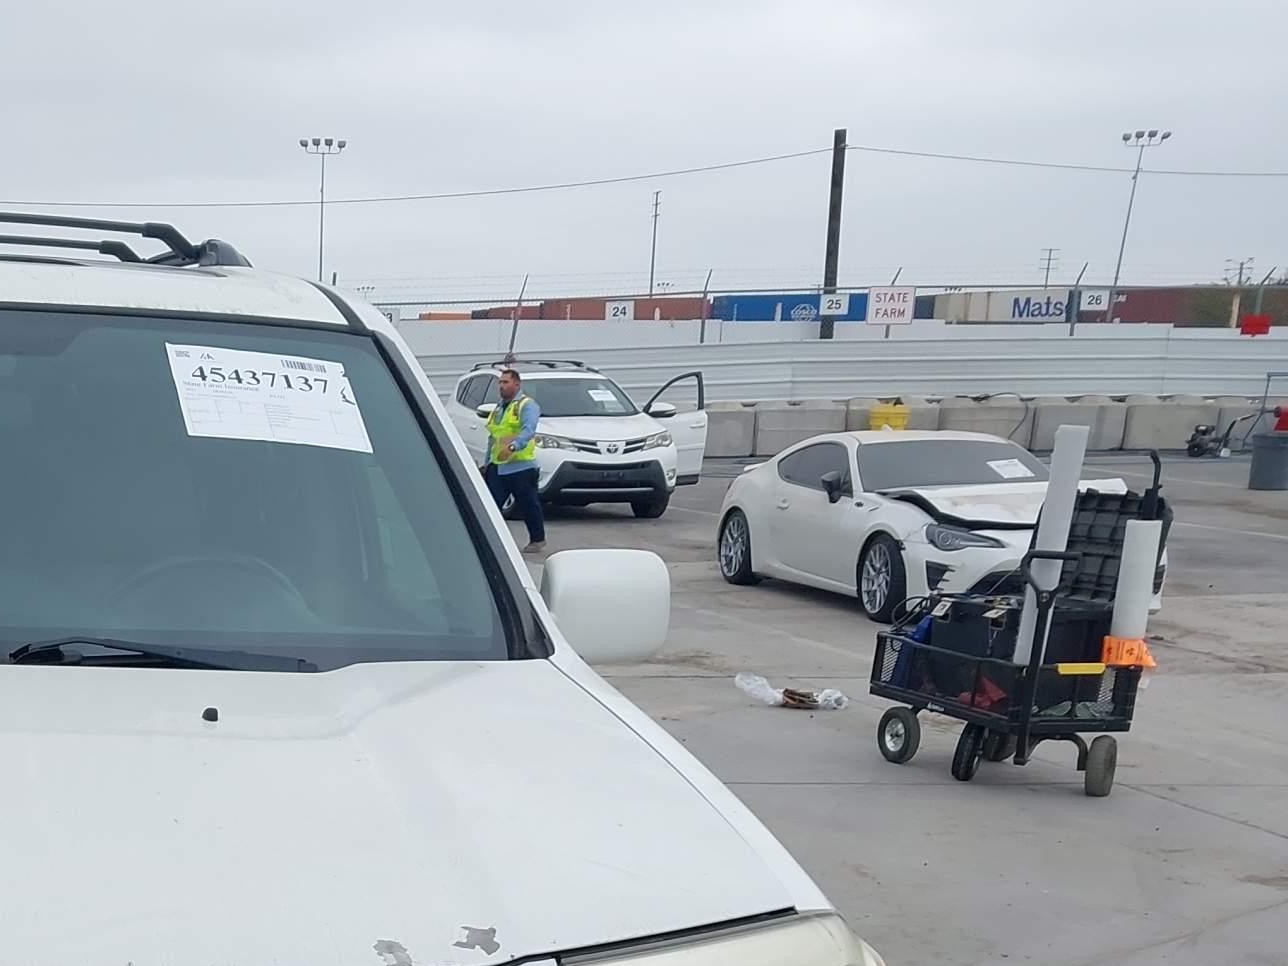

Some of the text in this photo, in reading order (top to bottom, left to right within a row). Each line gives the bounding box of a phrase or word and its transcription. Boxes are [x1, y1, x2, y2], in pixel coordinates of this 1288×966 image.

[874, 291, 909, 304] STATE
[1087, 295, 1103, 305] 26
[825, 299, 842, 311] 25
[1011, 296, 1068, 318] Mats
[612, 306, 627, 317] 24
[874, 307, 906, 319] FARM
[191, 365, 329, 394] 45437137
